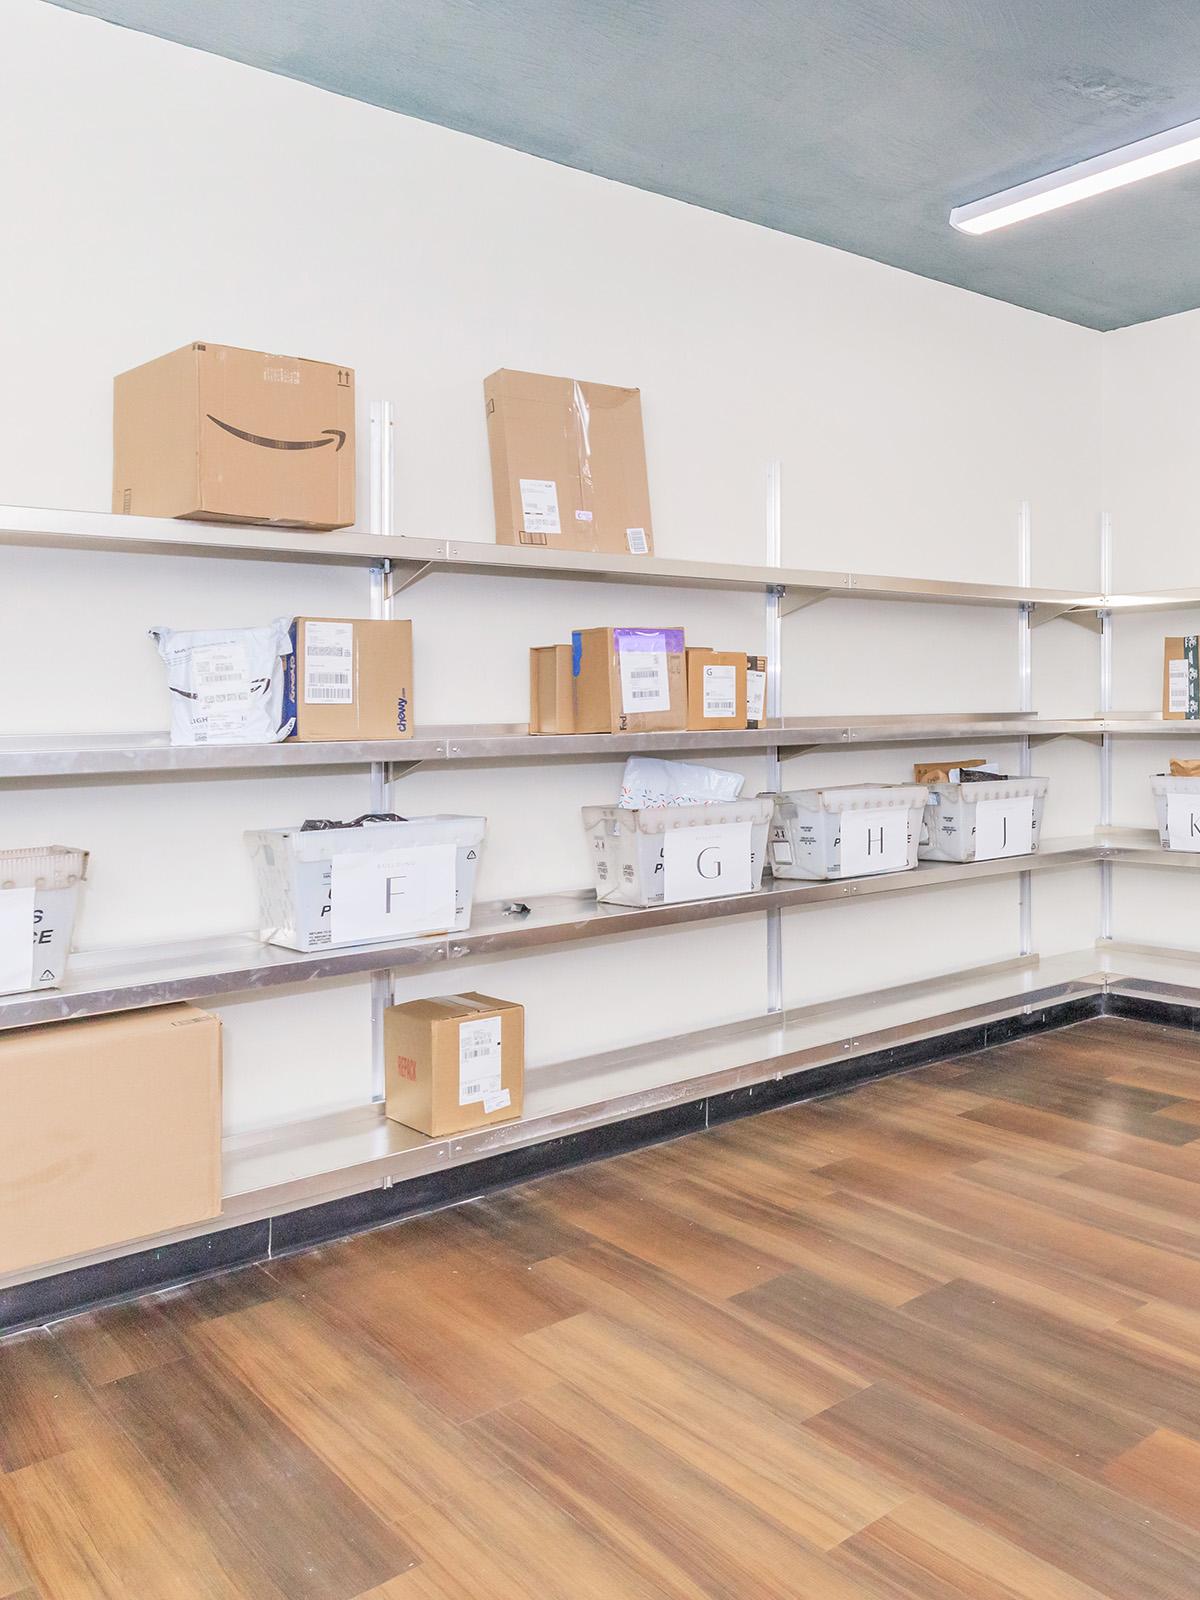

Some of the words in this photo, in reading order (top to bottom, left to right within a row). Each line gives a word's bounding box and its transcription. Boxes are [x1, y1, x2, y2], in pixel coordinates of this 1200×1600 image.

[706, 668, 713, 676] G
[868, 826, 884, 855] H
[1001, 817, 1006, 849] J
[696, 846, 722, 880] G
[385, 875, 407, 914] F
